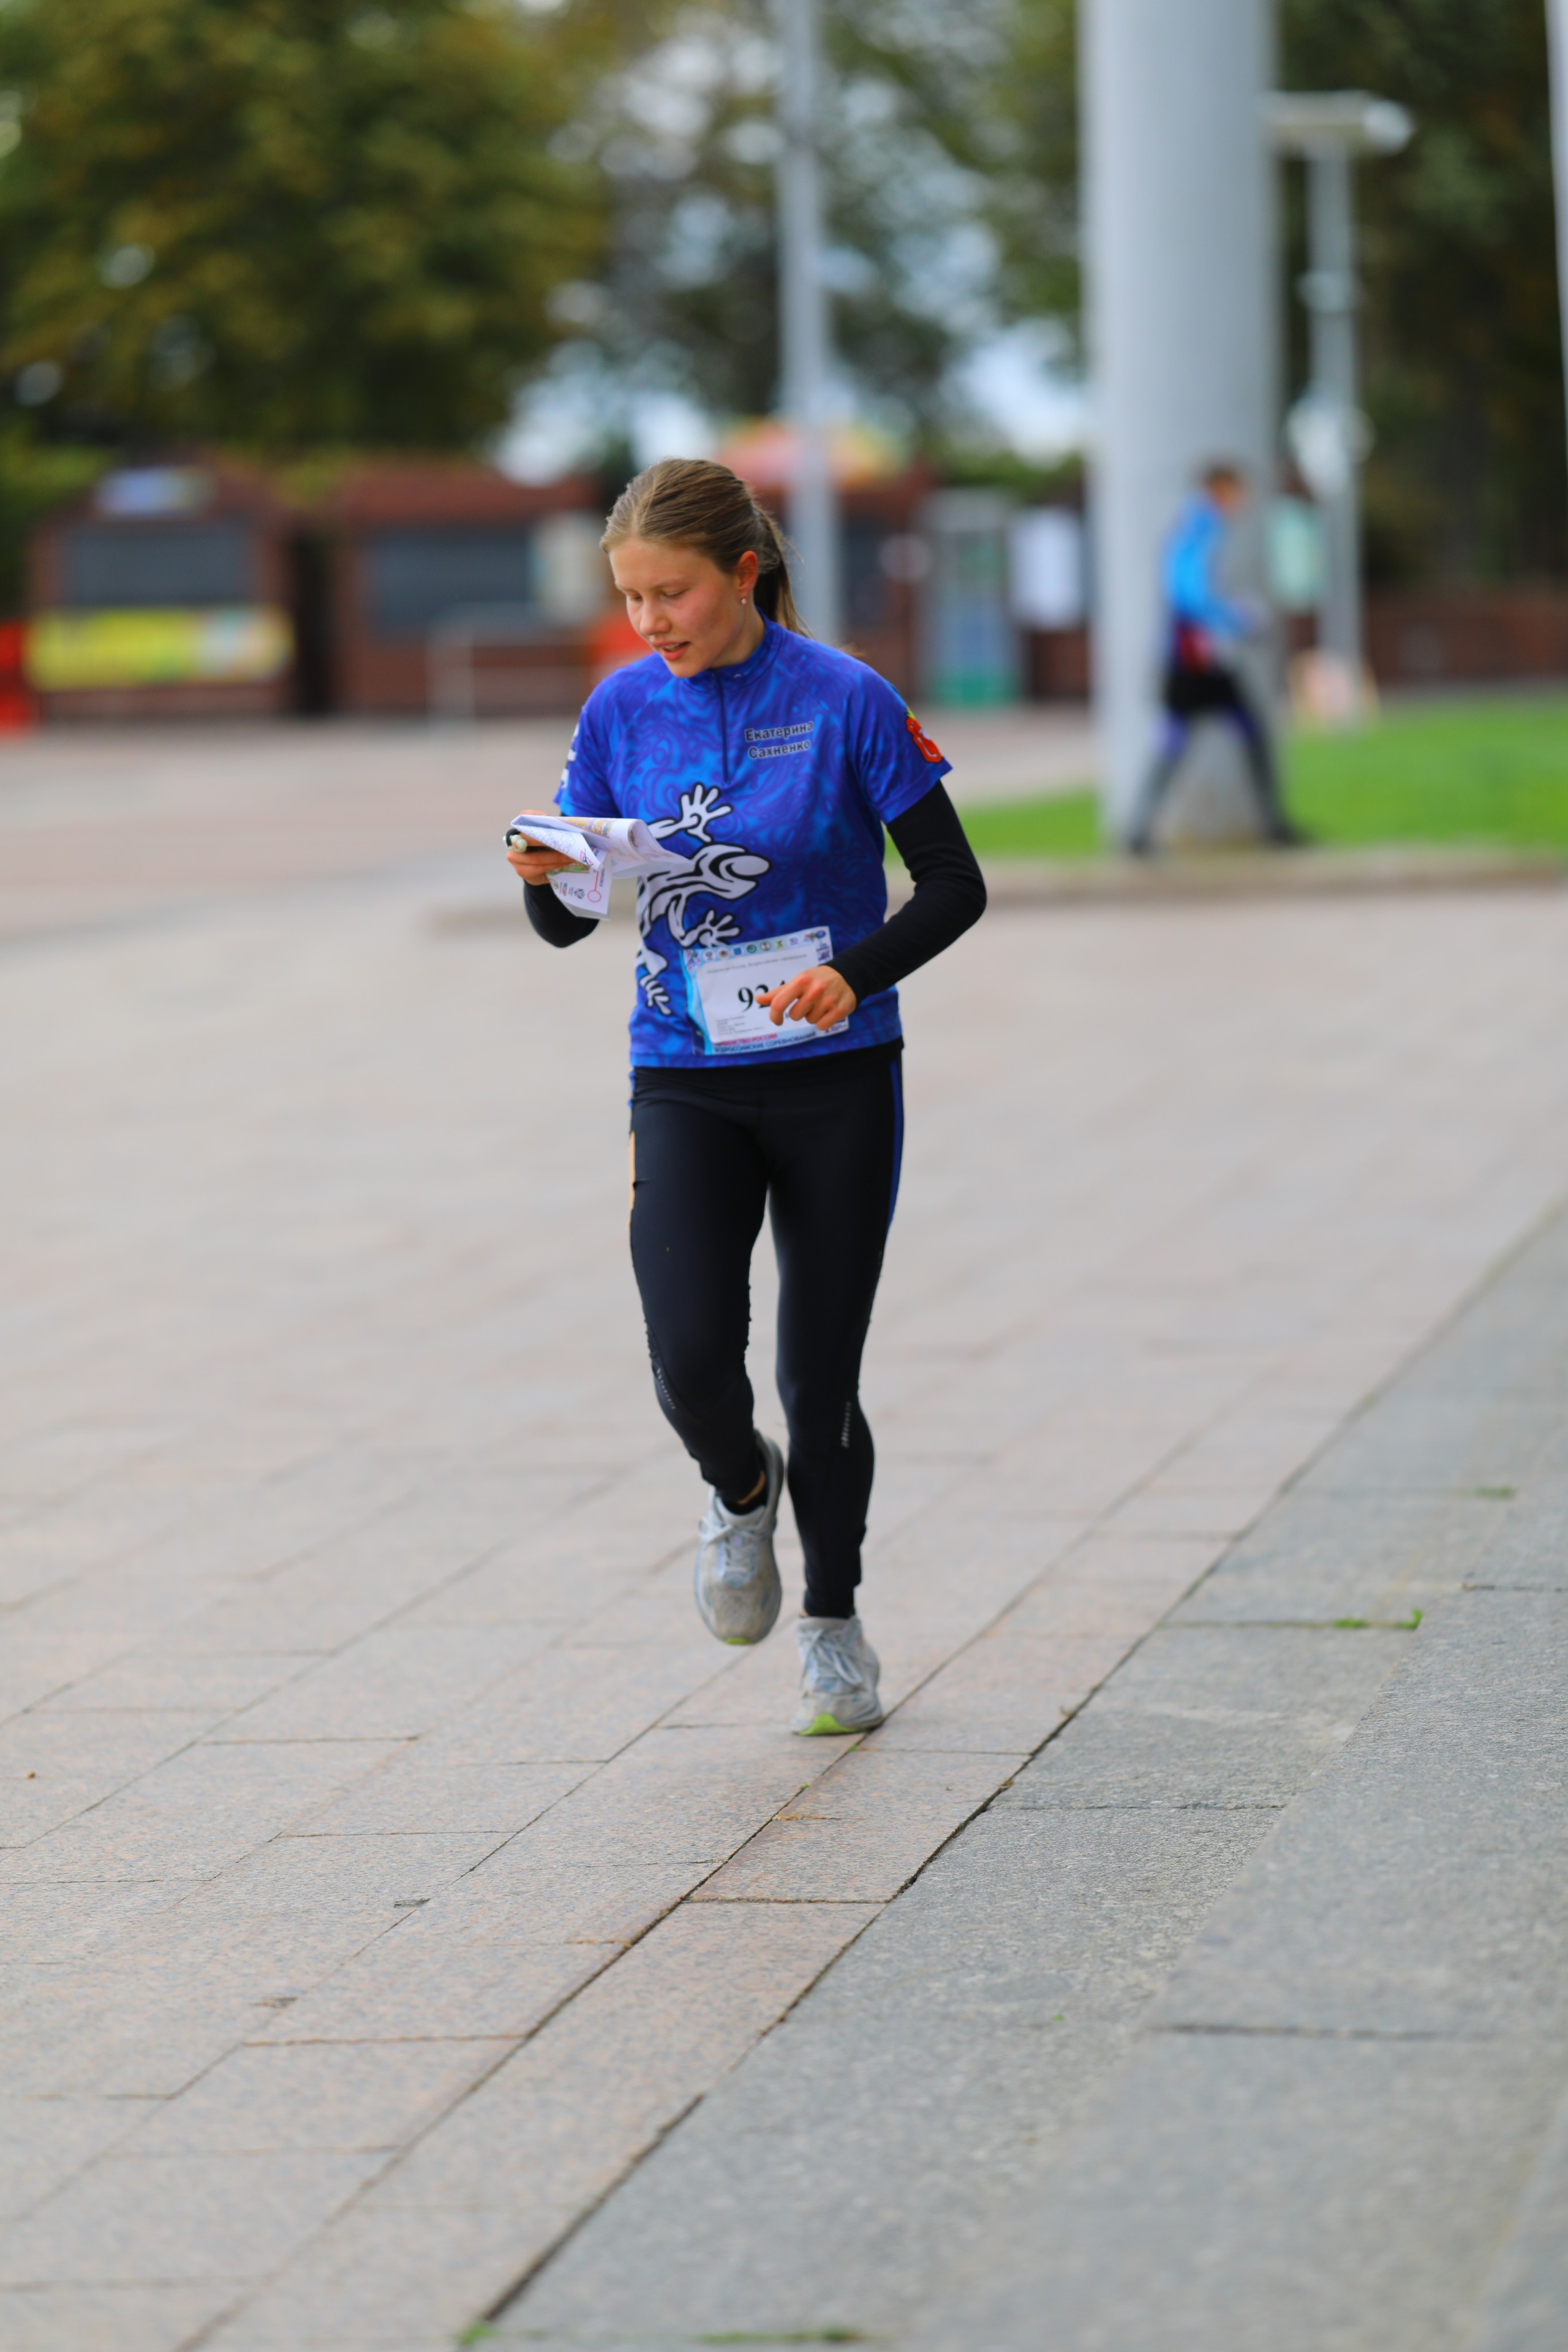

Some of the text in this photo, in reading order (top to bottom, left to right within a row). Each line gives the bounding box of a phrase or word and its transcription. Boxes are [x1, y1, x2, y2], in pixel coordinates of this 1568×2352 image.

[745, 722, 813, 742] Екатерина
[748, 740, 810, 759] Сахненко
[737, 980, 785, 1012] 92
